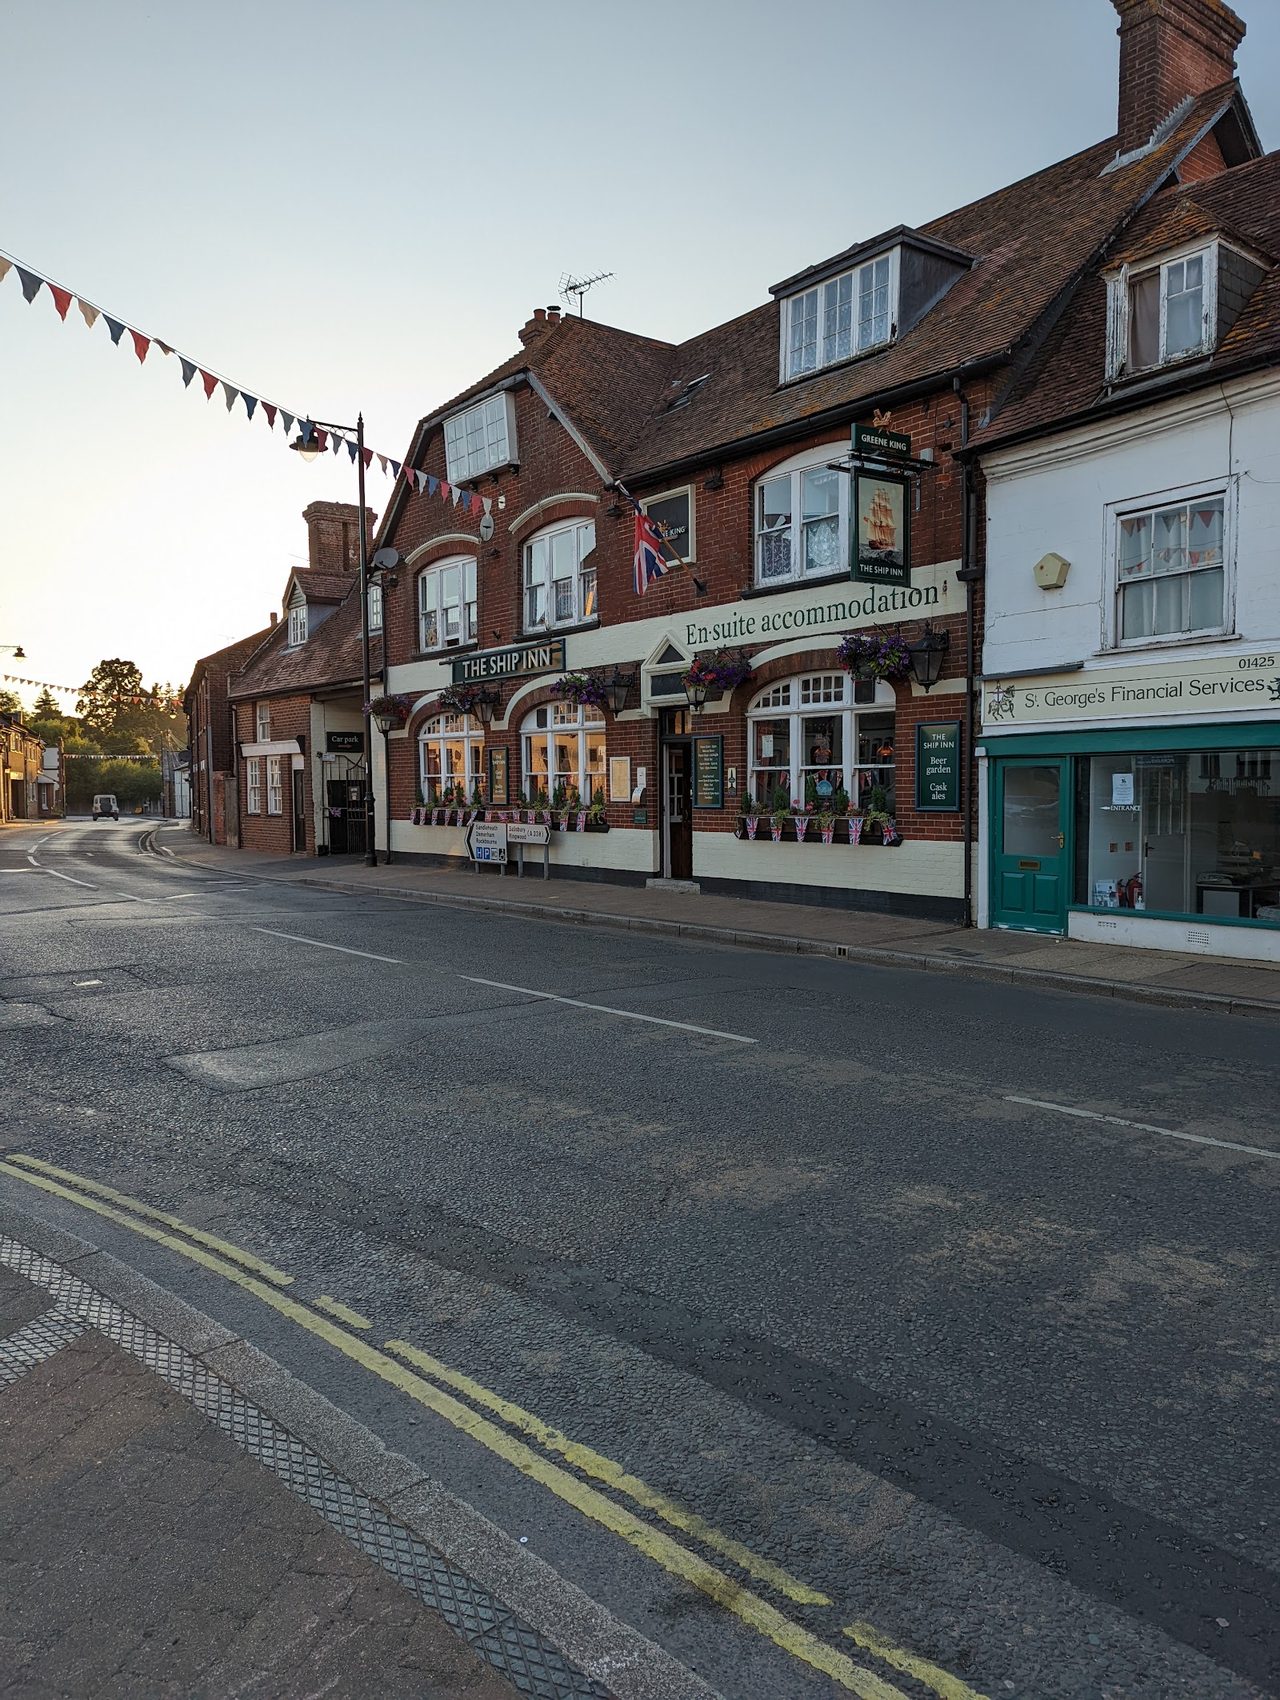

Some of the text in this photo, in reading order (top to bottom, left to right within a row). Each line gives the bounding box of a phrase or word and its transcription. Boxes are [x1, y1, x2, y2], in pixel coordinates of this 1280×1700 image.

[861, 433, 907, 451] GREENE KING
[670, 525, 686, 536] KING
[860, 563, 903, 577] THE SHIP INN
[761, 585, 939, 632] accommodation
[462, 646, 551, 678] THE SHIP INN
[1238, 656, 1275, 669] 01425
[1044, 688, 1106, 708] George's
[1111, 680, 1183, 702] Financial
[1189, 677, 1265, 696] Services
[331, 735, 359, 744] Car park
[932, 733, 946, 741] THE
[923, 741, 955, 750] SHIP INN
[930, 756, 947, 765] Beer
[926, 765, 951, 776] garden
[929, 782, 948, 792] Cask
[931, 791, 946, 800] ales
